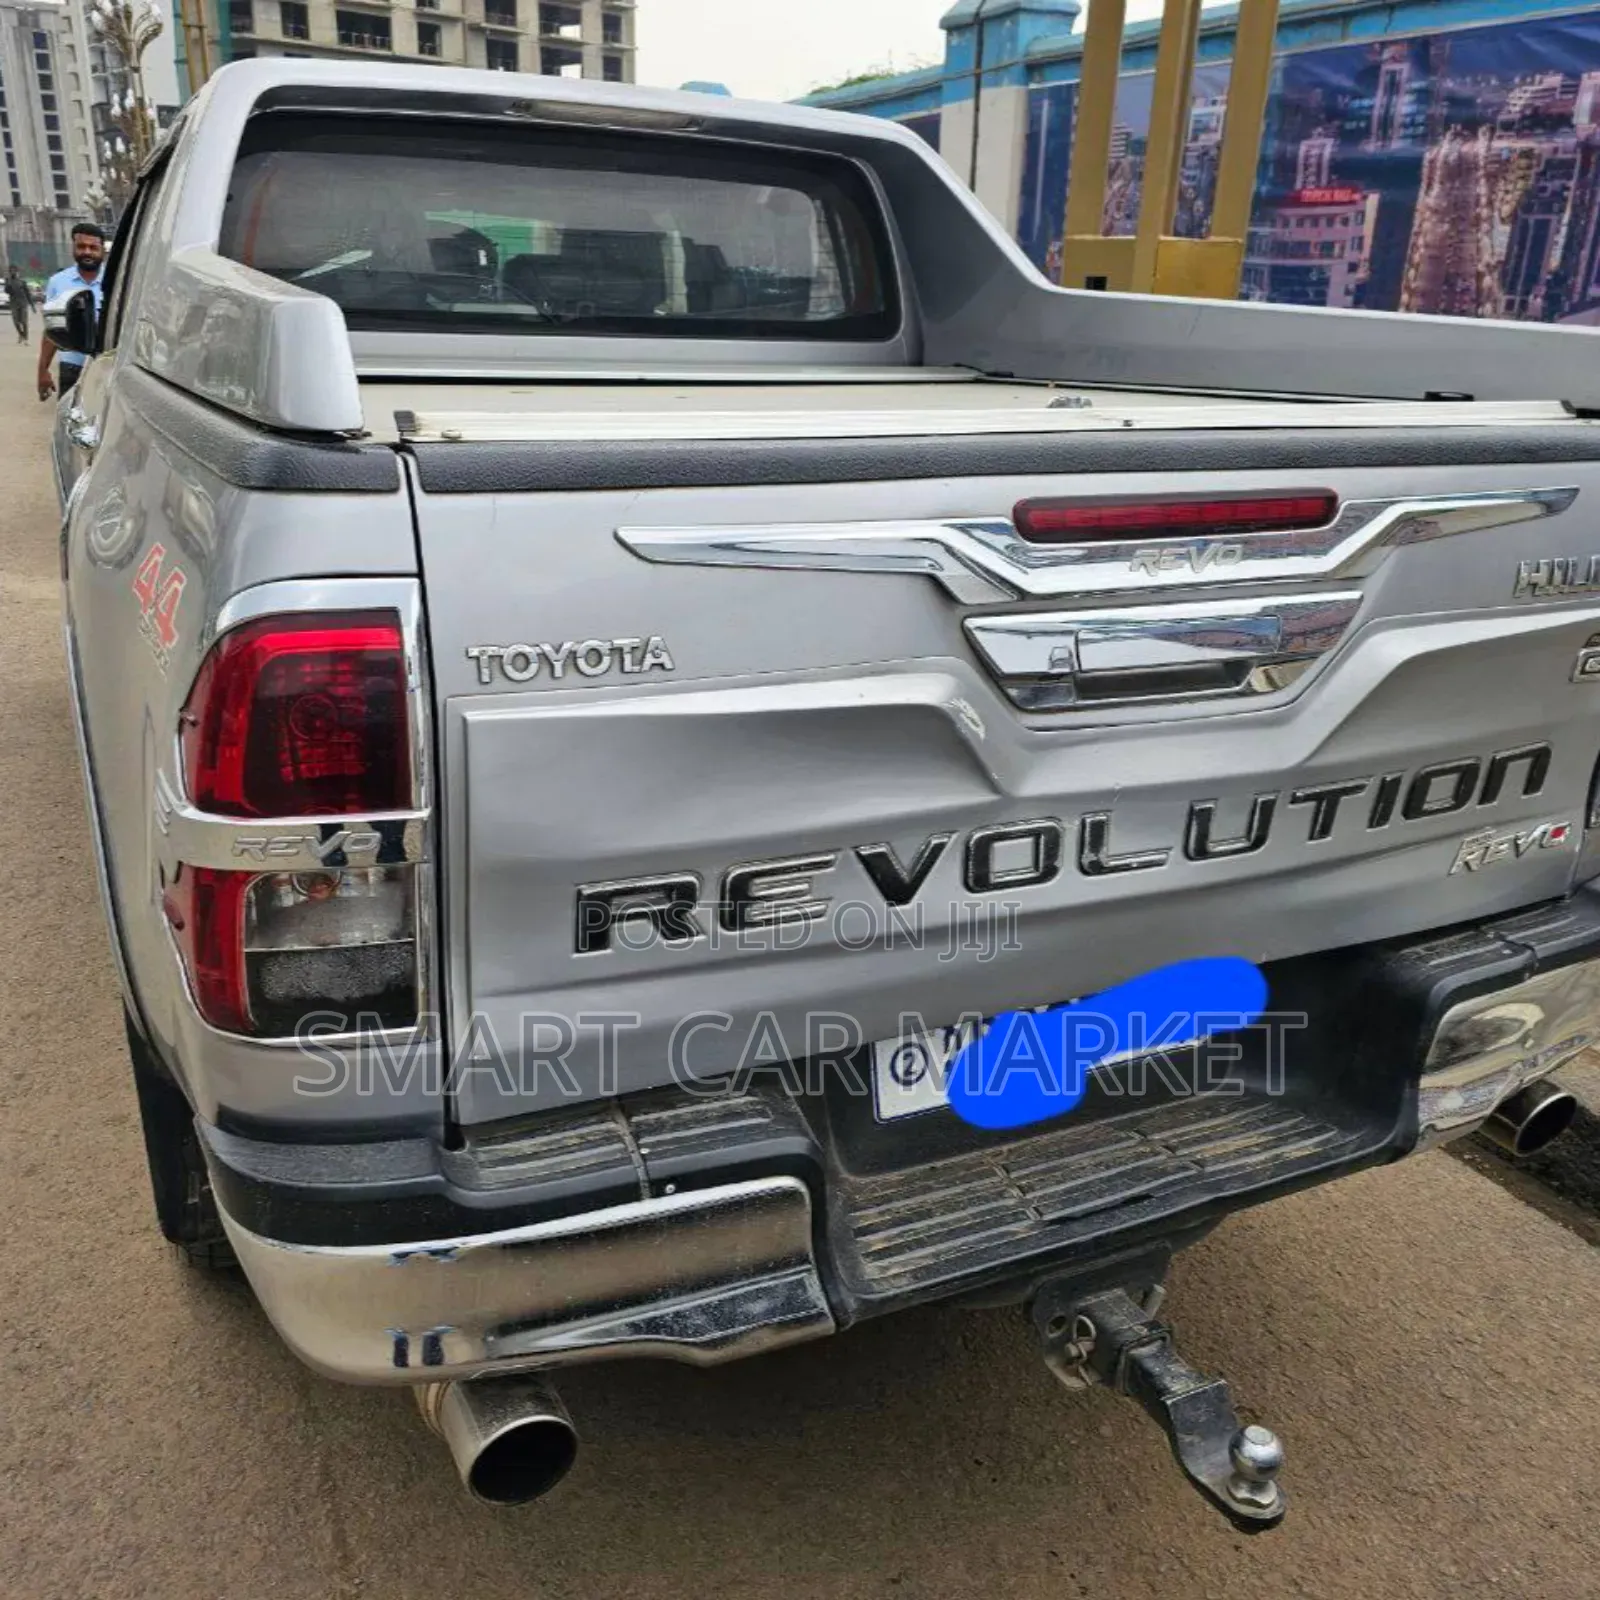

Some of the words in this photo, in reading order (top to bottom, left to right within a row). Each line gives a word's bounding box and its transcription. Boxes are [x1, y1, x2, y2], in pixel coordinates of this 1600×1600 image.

[1129, 542, 1243, 577] REVO
[466, 635, 676, 684] TOYOTA
[232, 831, 382, 862] REVO
[1448, 821, 1572, 876] REVO
